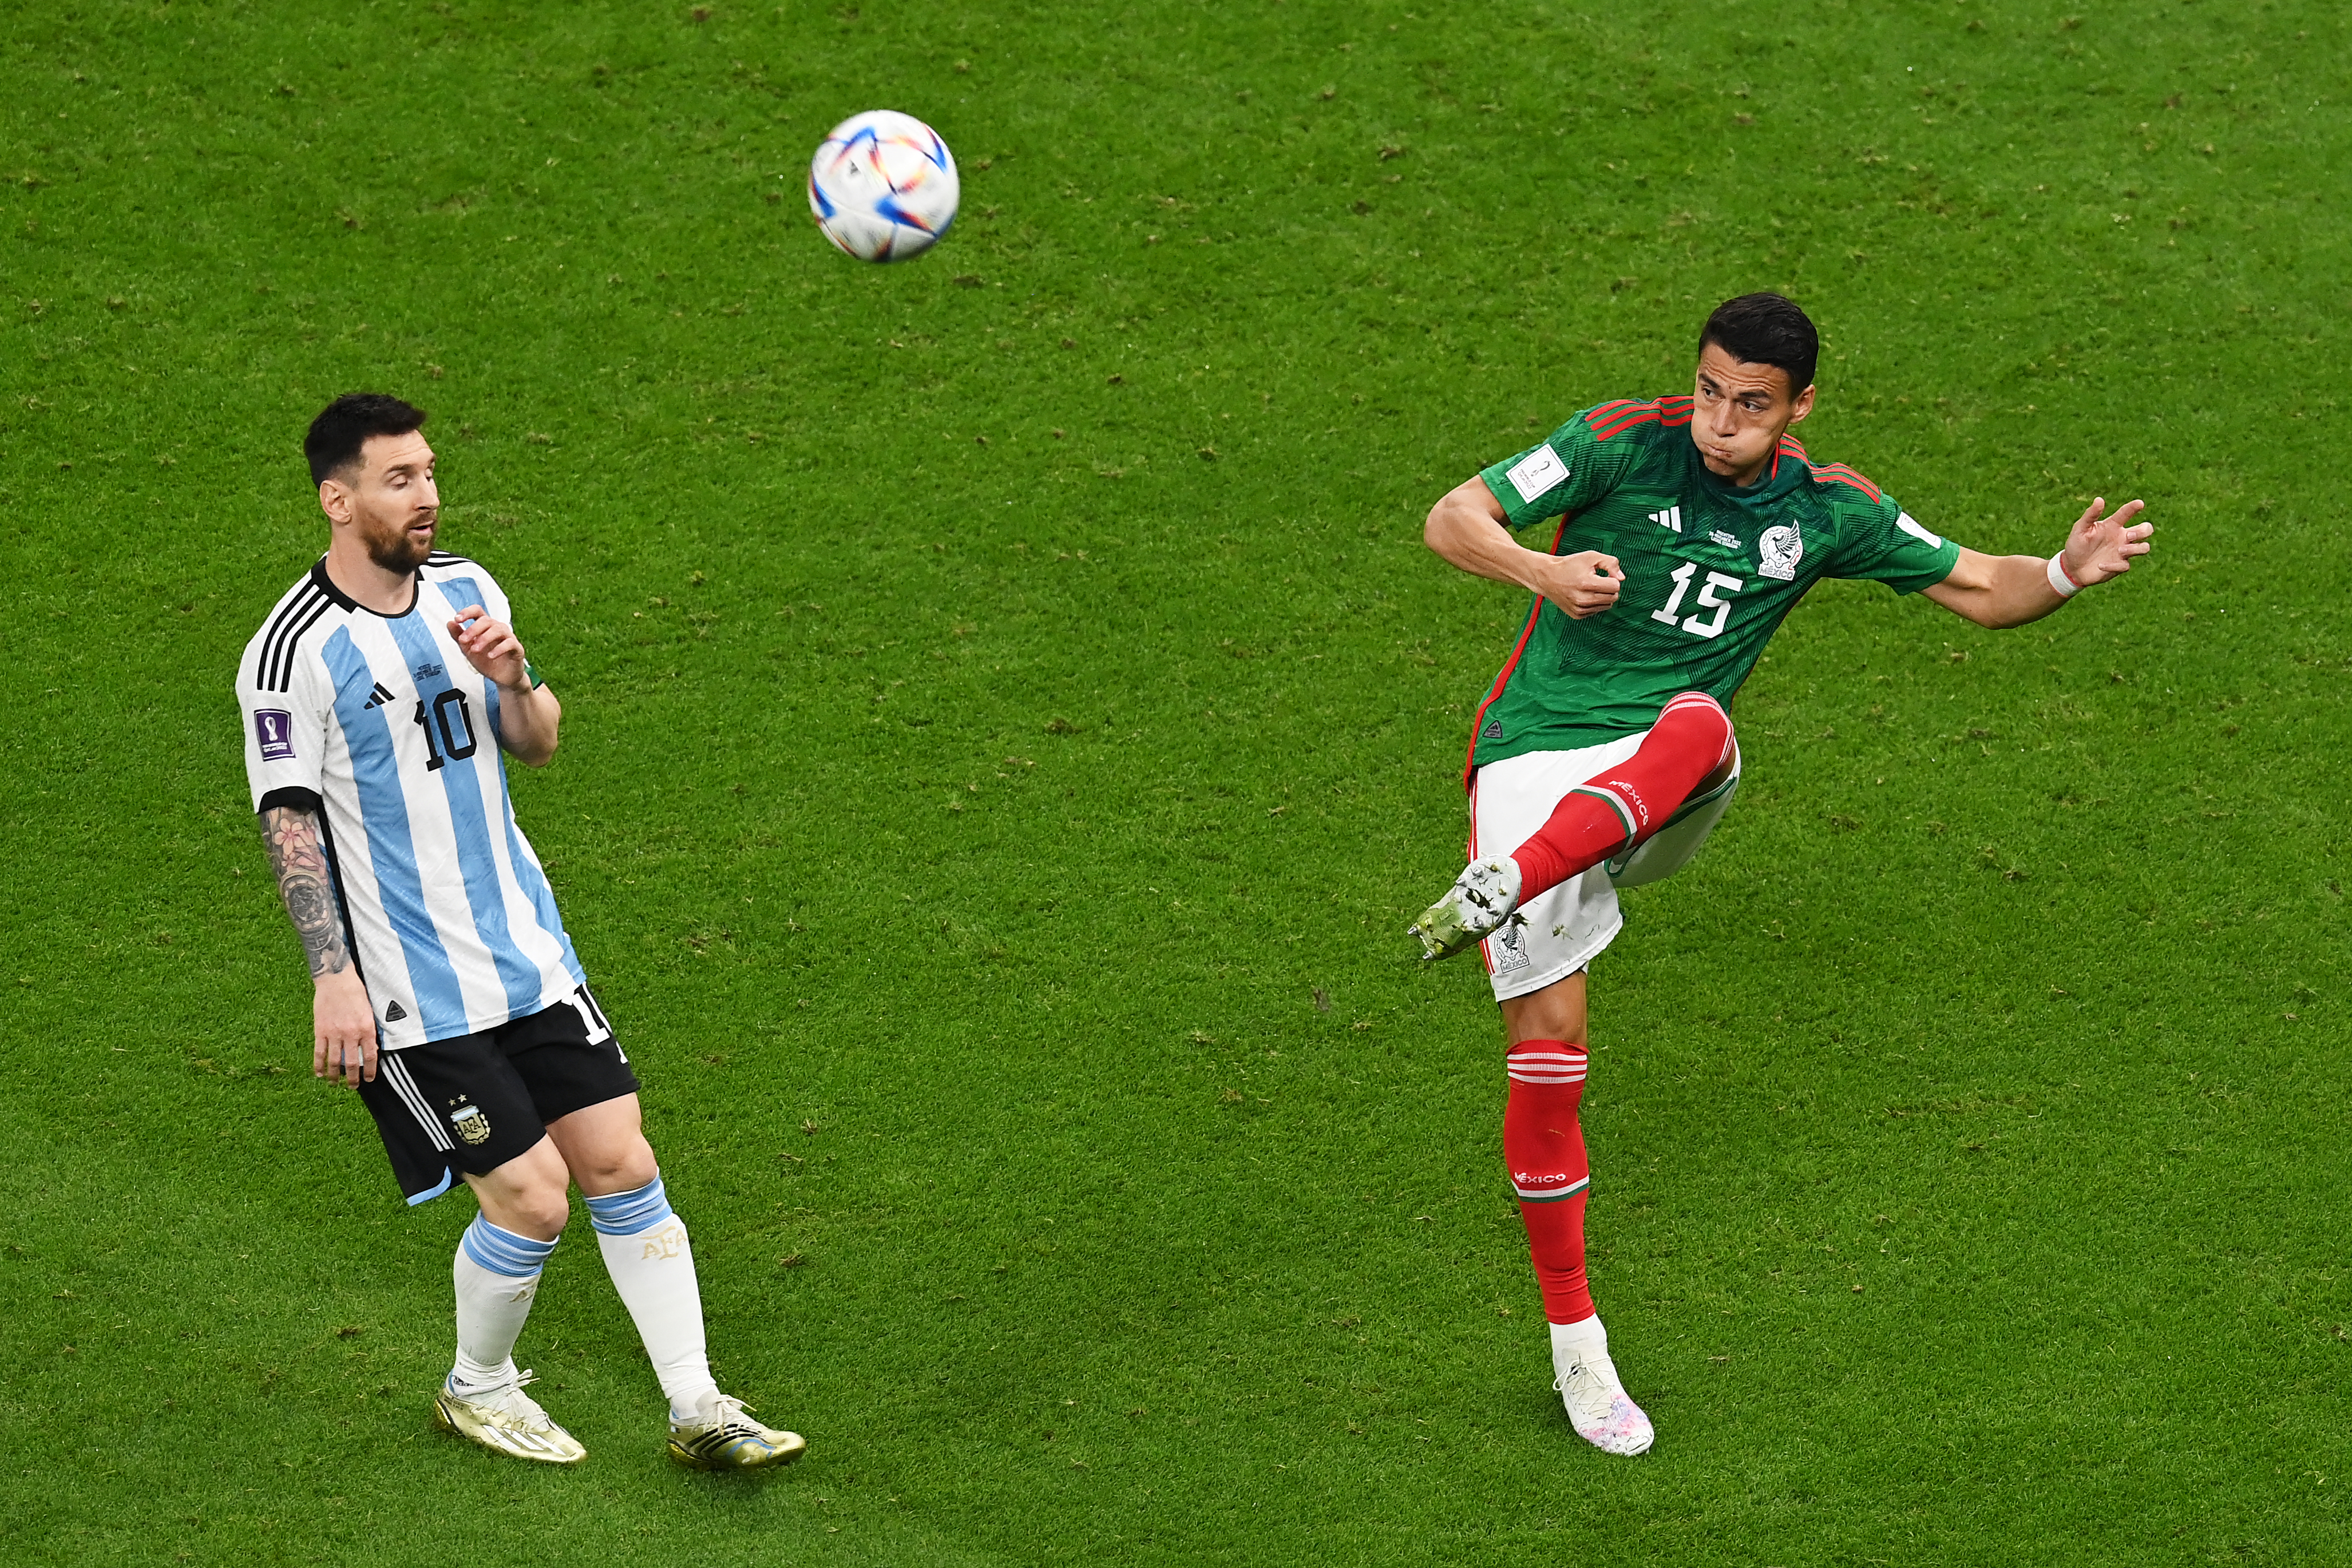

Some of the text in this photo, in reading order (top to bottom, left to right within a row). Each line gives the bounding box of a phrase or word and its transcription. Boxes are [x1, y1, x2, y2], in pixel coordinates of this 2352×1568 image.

[1651, 561, 1744, 639] 15
[414, 688, 477, 772] 10
[639, 1225, 687, 1260] AFA
